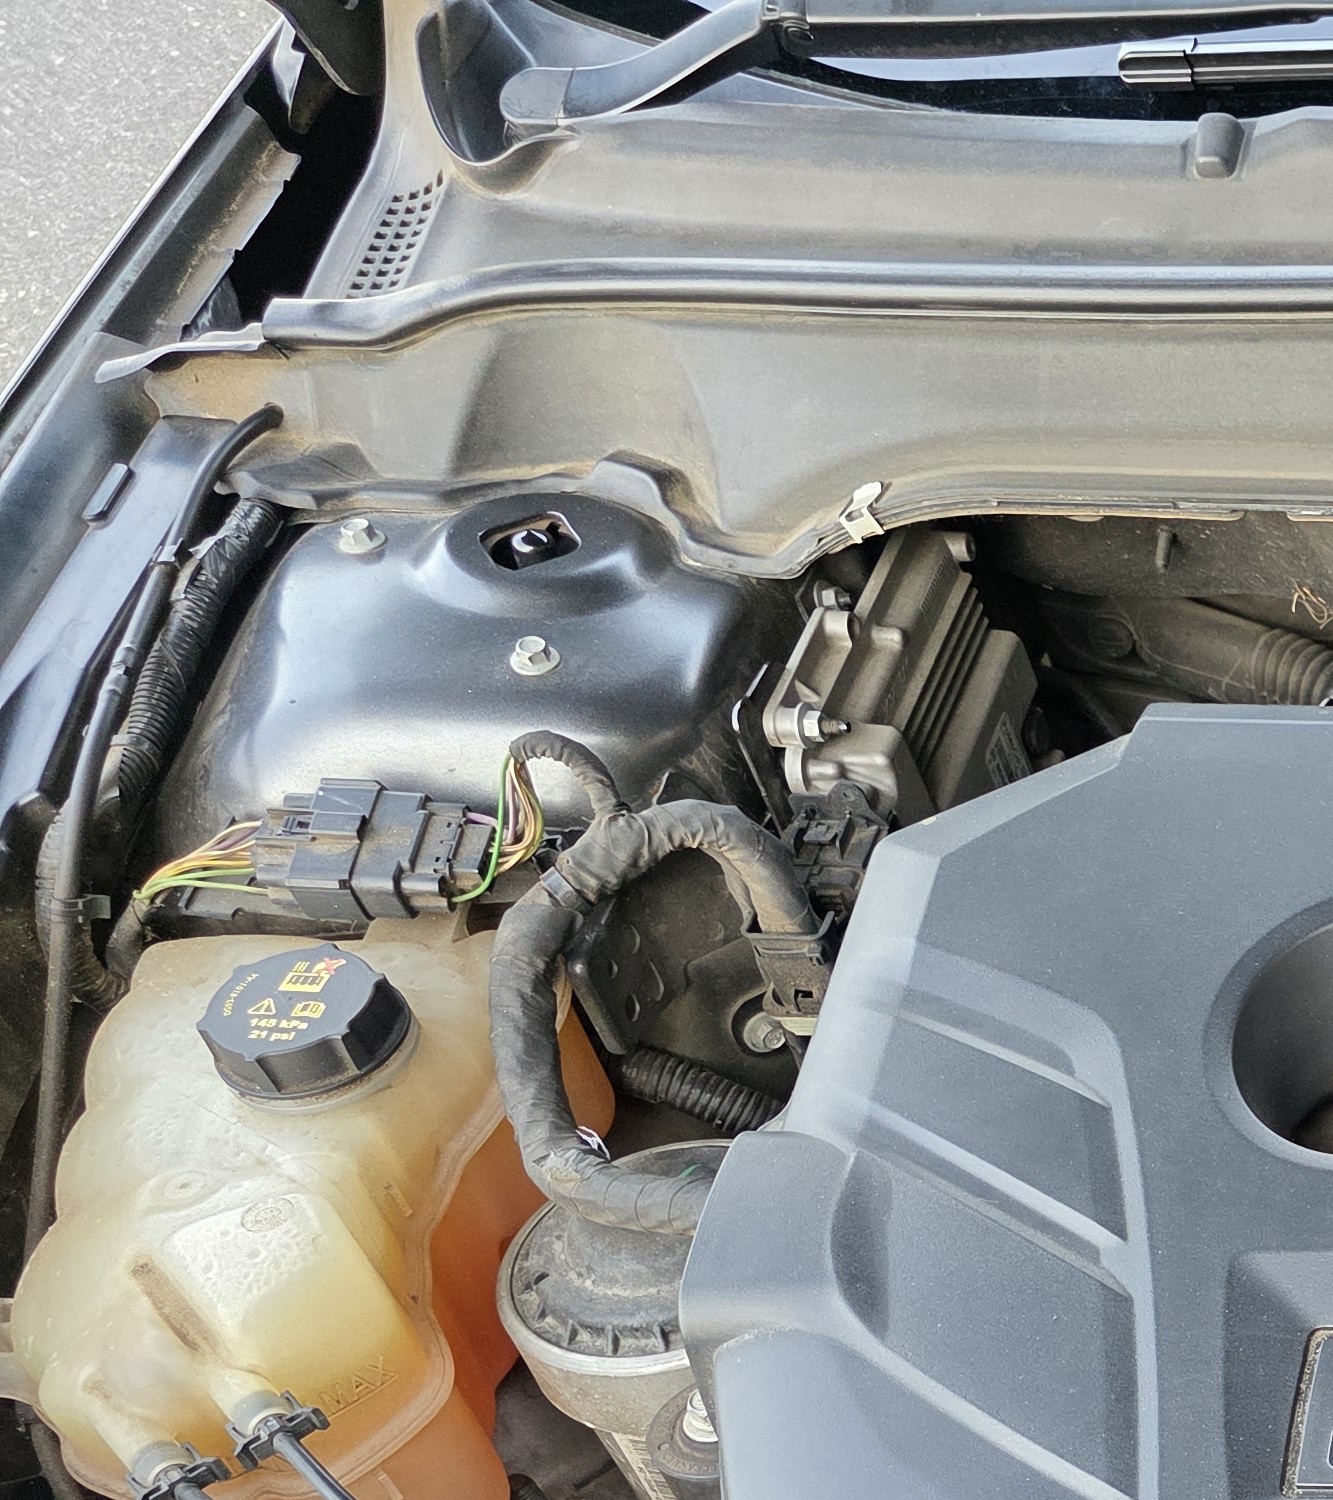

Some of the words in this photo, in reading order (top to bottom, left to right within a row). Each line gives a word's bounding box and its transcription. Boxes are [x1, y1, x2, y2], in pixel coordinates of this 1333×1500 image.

[250, 1018, 277, 1028] 145
[279, 1020, 309, 1030] kPa
[248, 1031, 268, 1040] 21
[269, 1032, 296, 1042] psi
[319, 1356, 397, 1412] MAX
